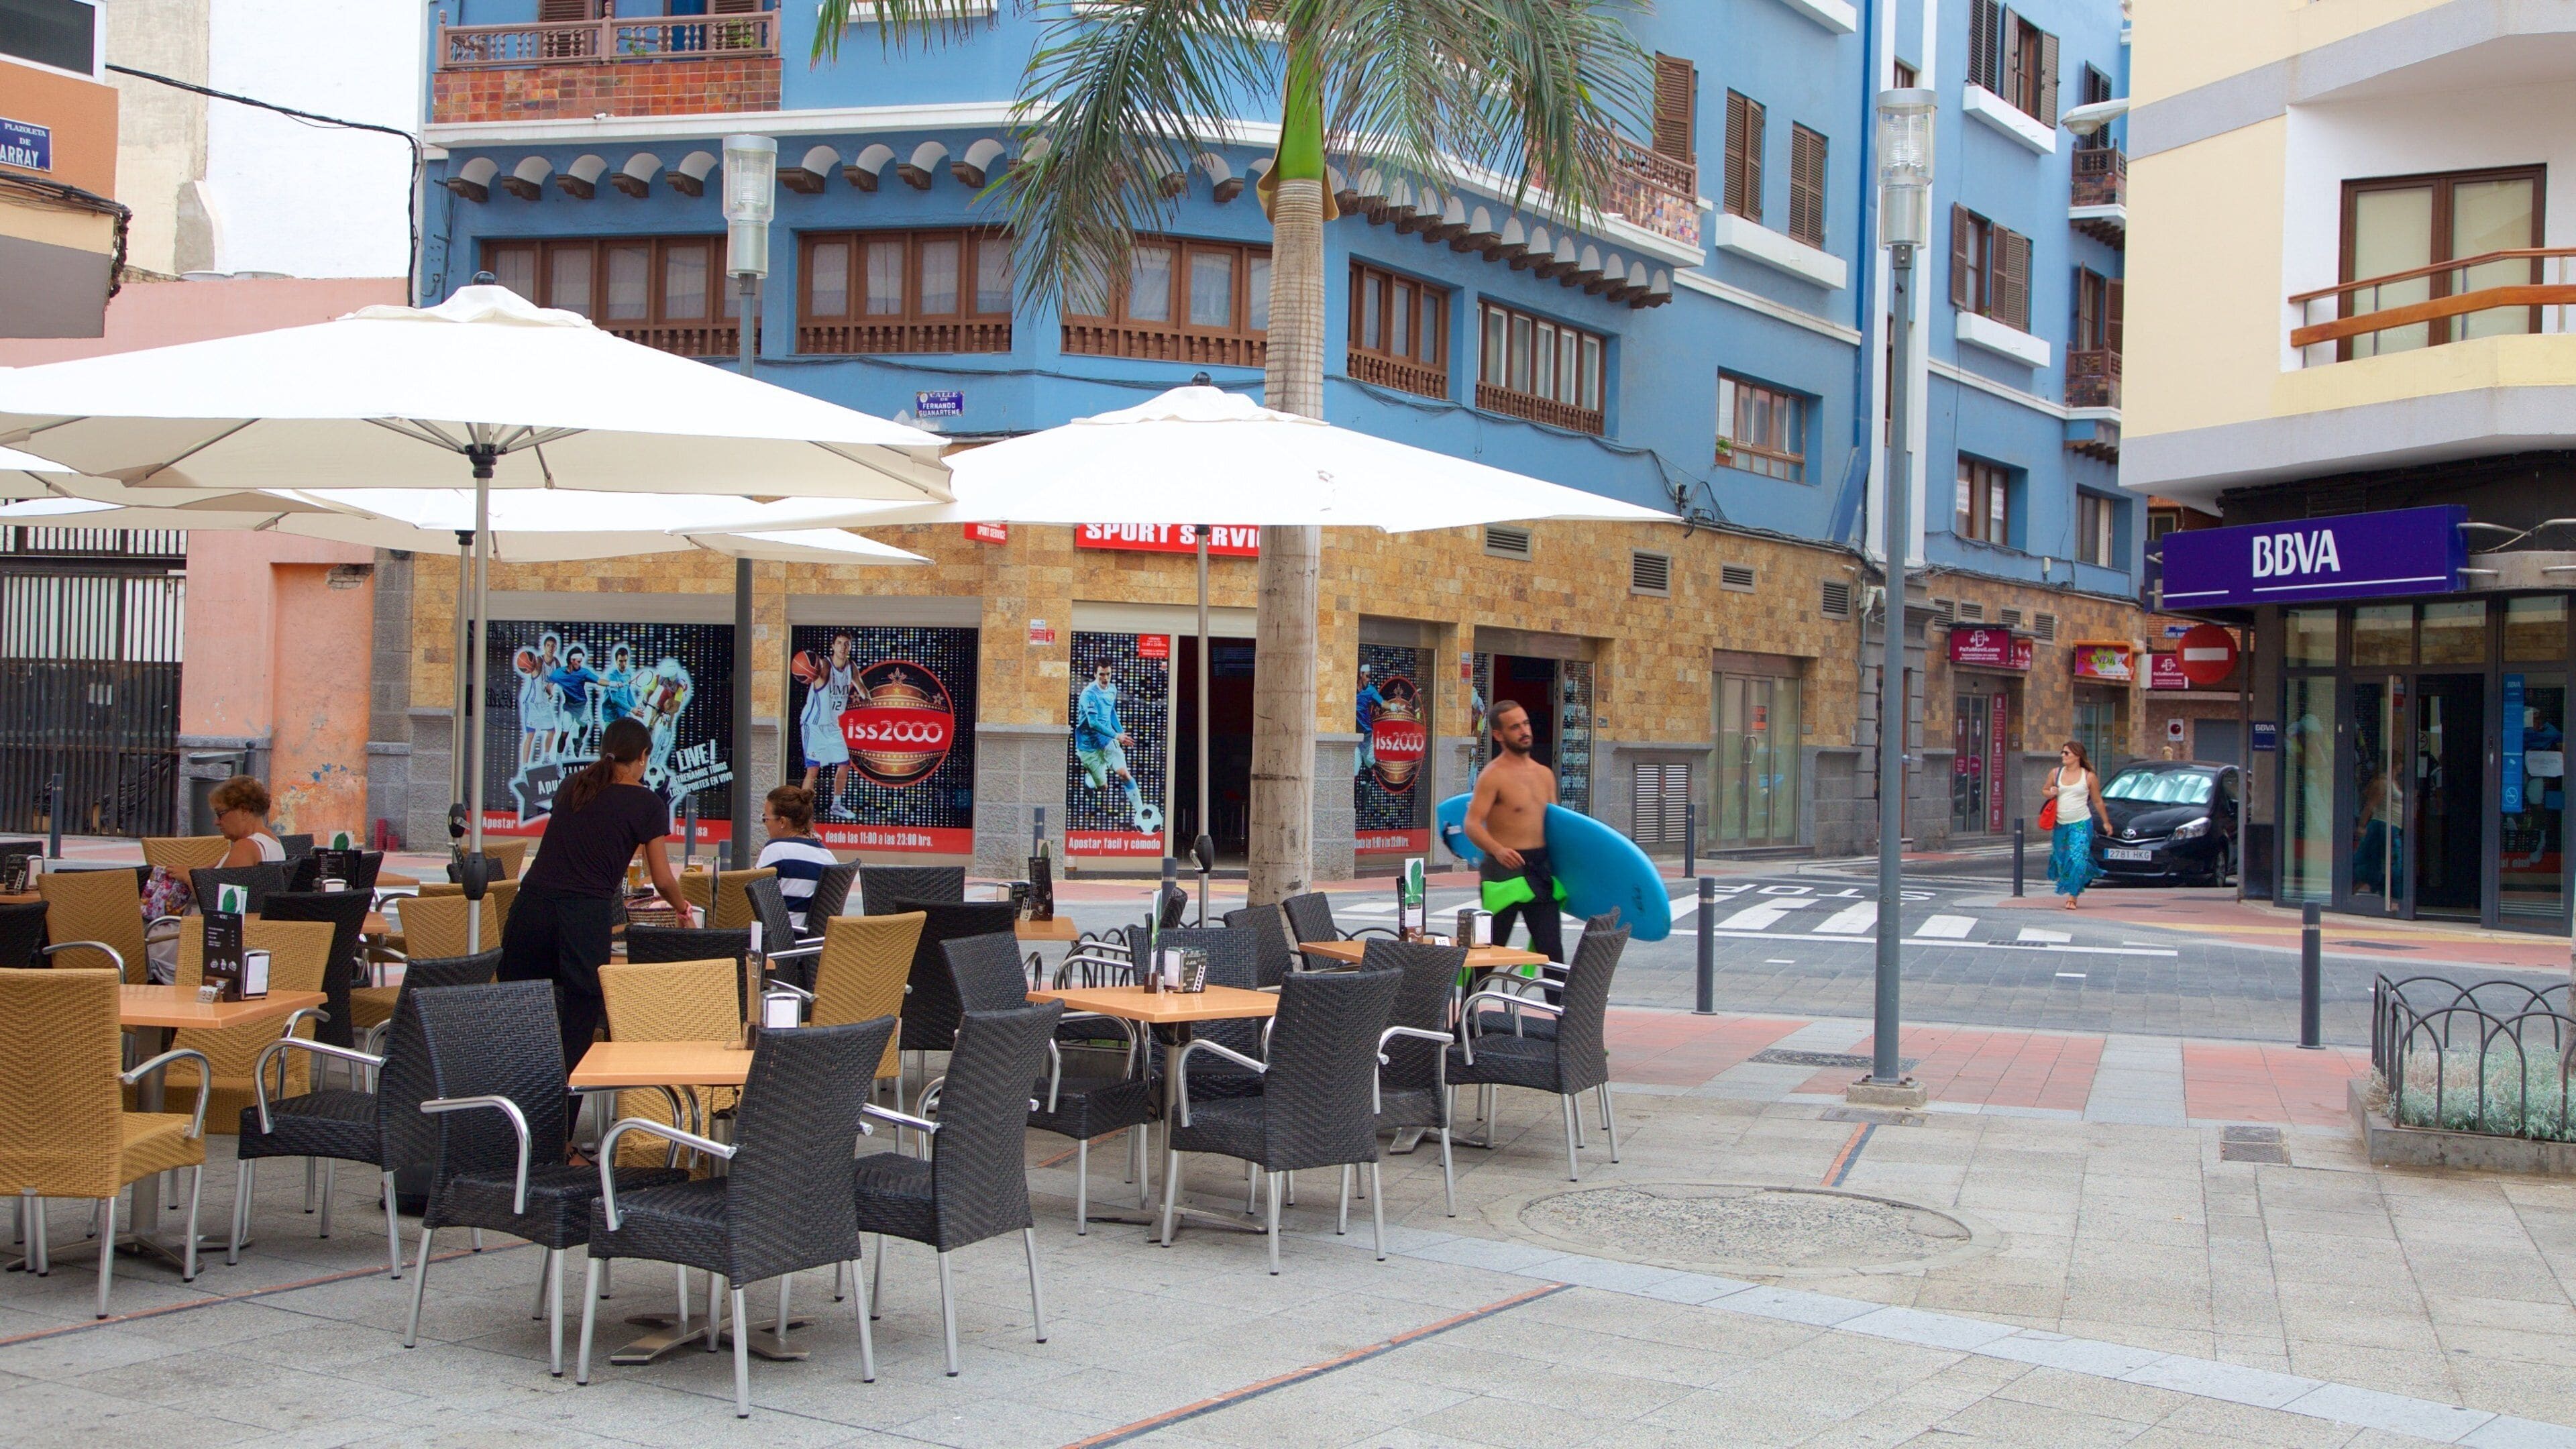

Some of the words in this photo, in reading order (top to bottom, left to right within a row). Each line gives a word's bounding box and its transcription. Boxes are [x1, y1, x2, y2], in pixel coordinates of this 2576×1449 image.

[5, 123, 46, 137] PLAZOLETA
[19, 138, 31, 146] DE
[918, 409, 961, 417] GUANARTEME
[977, 525, 989, 537] SPORT
[990, 529, 1006, 540] SERVICE
[1085, 524, 1171, 544] SPORT
[1179, 525, 1260, 548] SRVI
[2253, 529, 2341, 578] BBVA
[832, 700, 842, 711] 12
[847, 718, 943, 743] iss2000
[1376, 731, 1424, 752] iss2000
[676, 739, 716, 772] LIVE!
[708, 761, 728, 775] TODOS
[710, 775, 719, 786] EN
[718, 771, 734, 784] VIVO
[482, 816, 516, 831] Apostar
[676, 824, 686, 836] tu
[825, 830, 846, 843] desde
[847, 831, 859, 844] las
[859, 832, 876, 845] 11:00
[878, 835, 882, 845] a
[884, 833, 895, 845] las
[896, 833, 916, 846] 23:00
[918, 834, 933, 847] hrs.
[1104, 837, 1122, 849] fácil
[1124, 839, 1129, 851] y
[1130, 837, 1161, 849] cómodo
[2110, 850, 2130, 859] 2781
[2133, 851, 2149, 859] HKG
